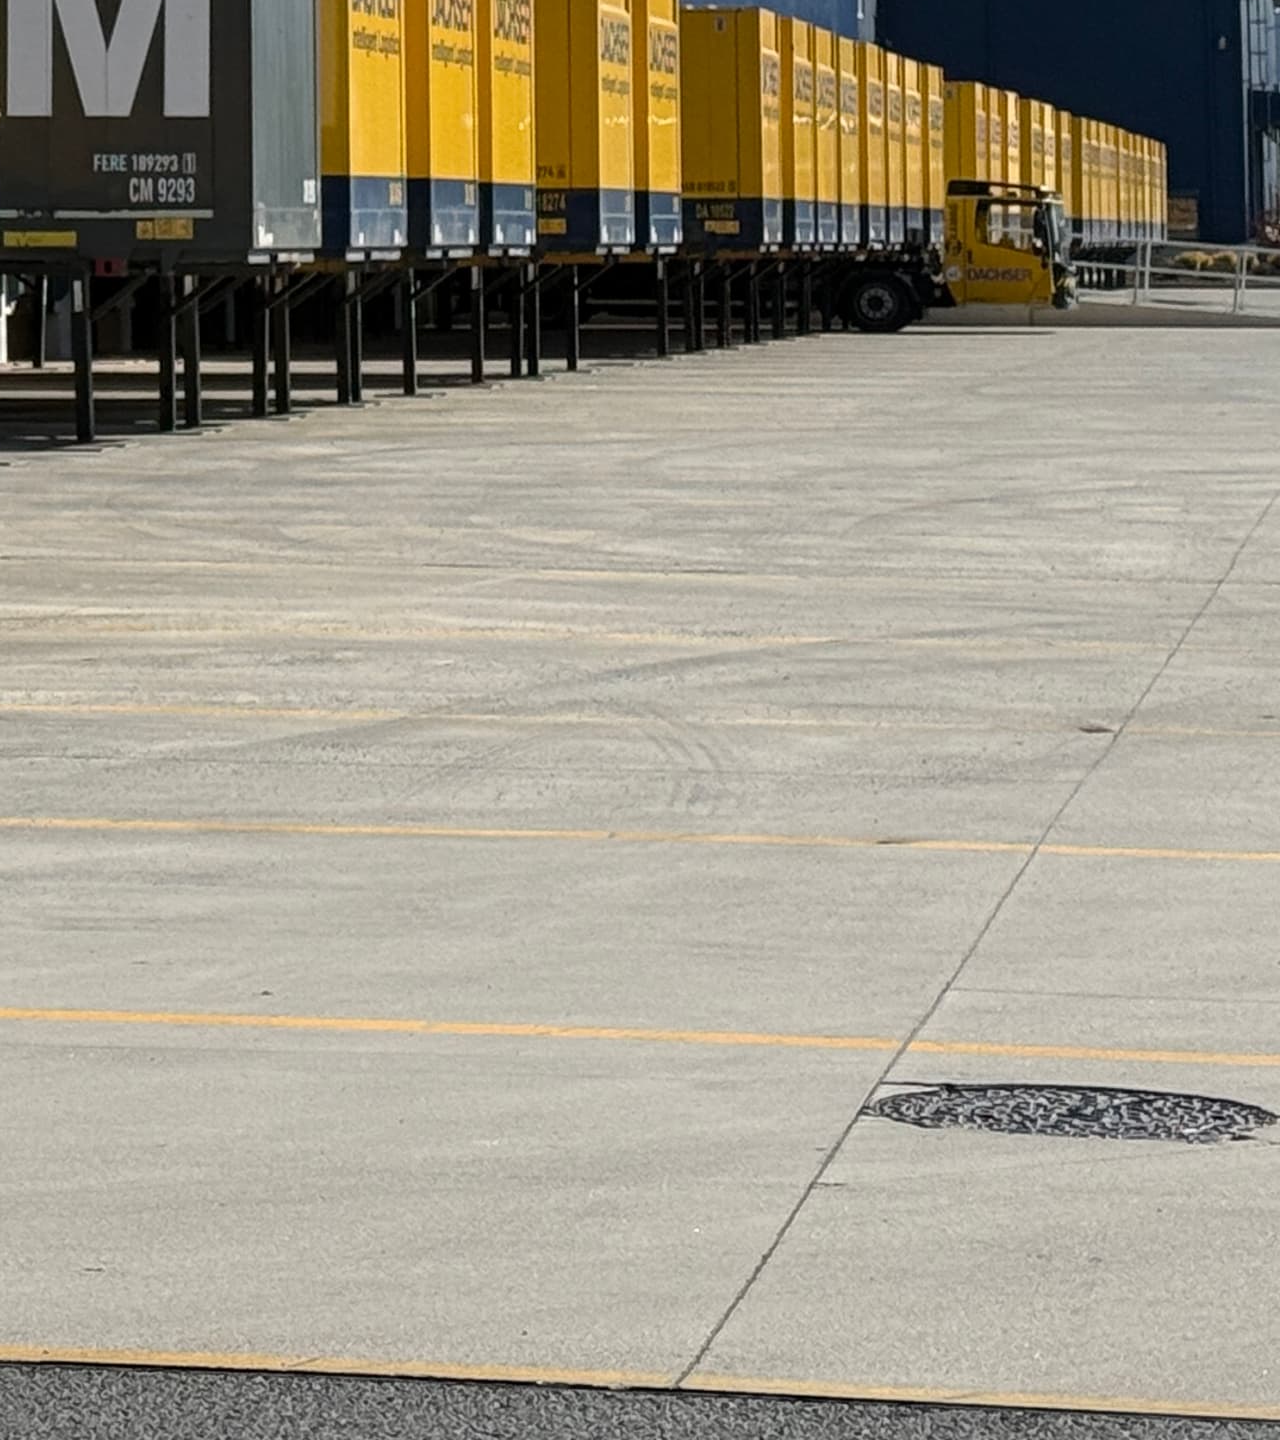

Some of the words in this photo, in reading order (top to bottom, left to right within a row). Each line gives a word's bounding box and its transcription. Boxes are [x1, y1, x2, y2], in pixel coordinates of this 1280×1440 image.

[93, 153, 128, 173] FERE
[129, 177, 154, 203] CM
[158, 177, 196, 203] 9293
